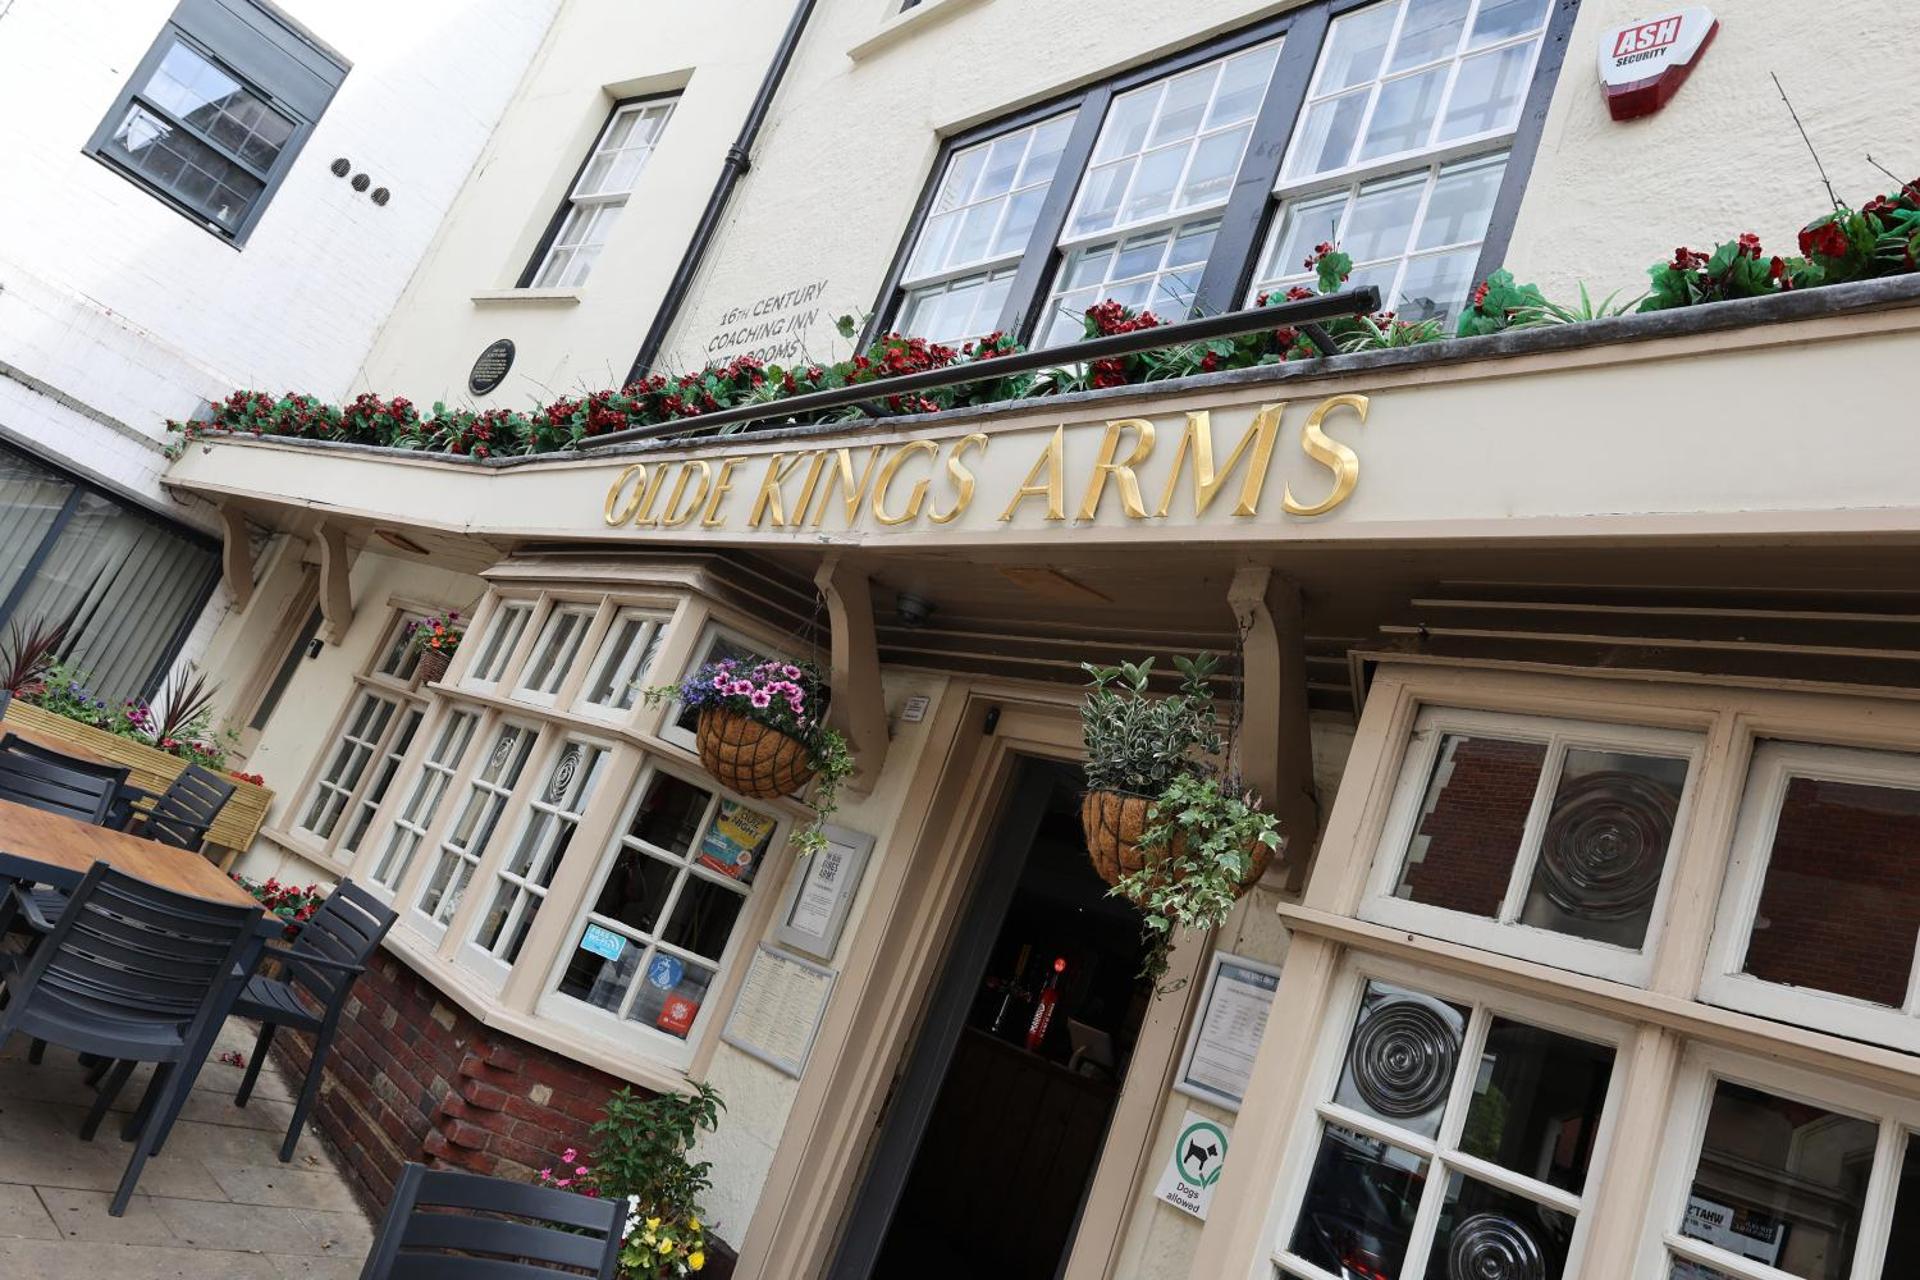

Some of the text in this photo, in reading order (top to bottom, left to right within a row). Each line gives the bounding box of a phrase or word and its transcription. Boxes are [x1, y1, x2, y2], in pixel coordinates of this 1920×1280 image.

[1615, 18, 1679, 55] ASH
[1616, 47, 1667, 67] SECURITY
[720, 279, 828, 326] 16TH CENTURY
[708, 307, 819, 353] COACHING INN
[603, 393, 1370, 529] OLDE KINGS ARMS
[1166, 1192, 1201, 1213] allowed
[1177, 1182, 1200, 1199] Dogs
